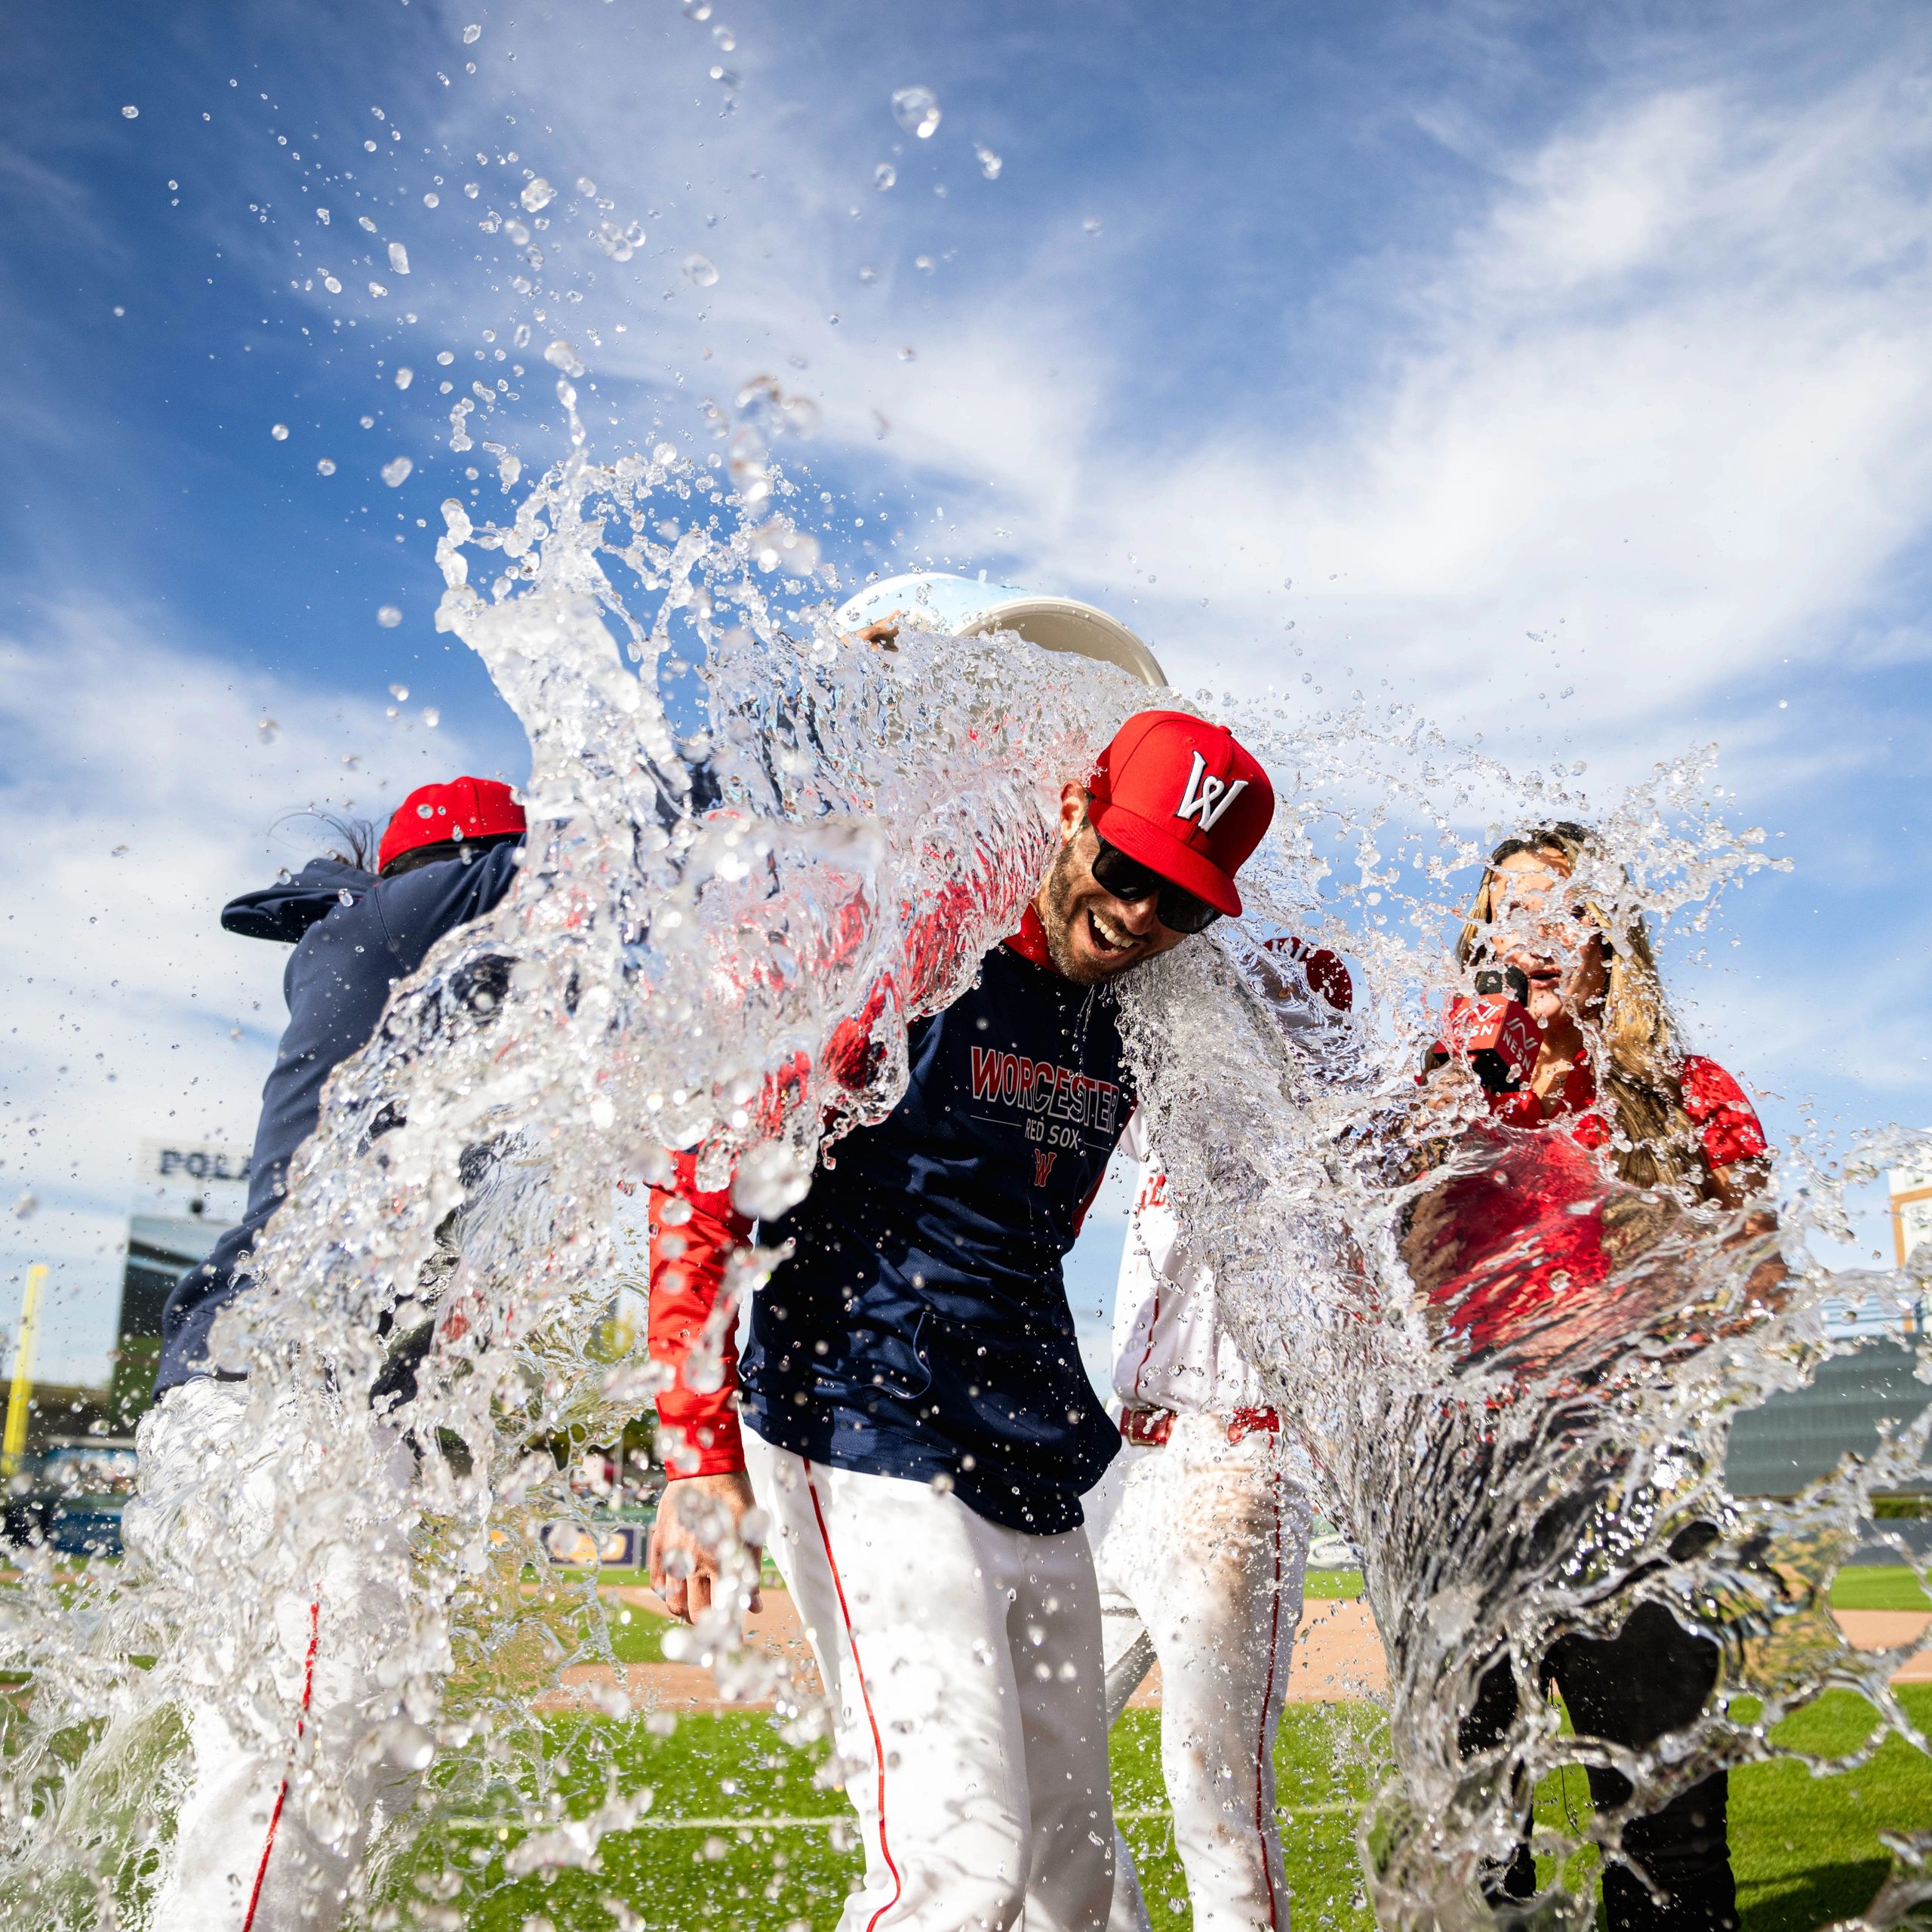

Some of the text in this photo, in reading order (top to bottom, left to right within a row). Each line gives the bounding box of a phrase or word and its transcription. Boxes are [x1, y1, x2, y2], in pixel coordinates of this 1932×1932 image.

[1453, 1023, 1494, 1036] SN
[1502, 1029, 1531, 1072] NESN
[971, 1045, 1120, 1134] WORCESTER
[1024, 1118, 1079, 1149] RED SOX
[1034, 1148, 1057, 1187] W
